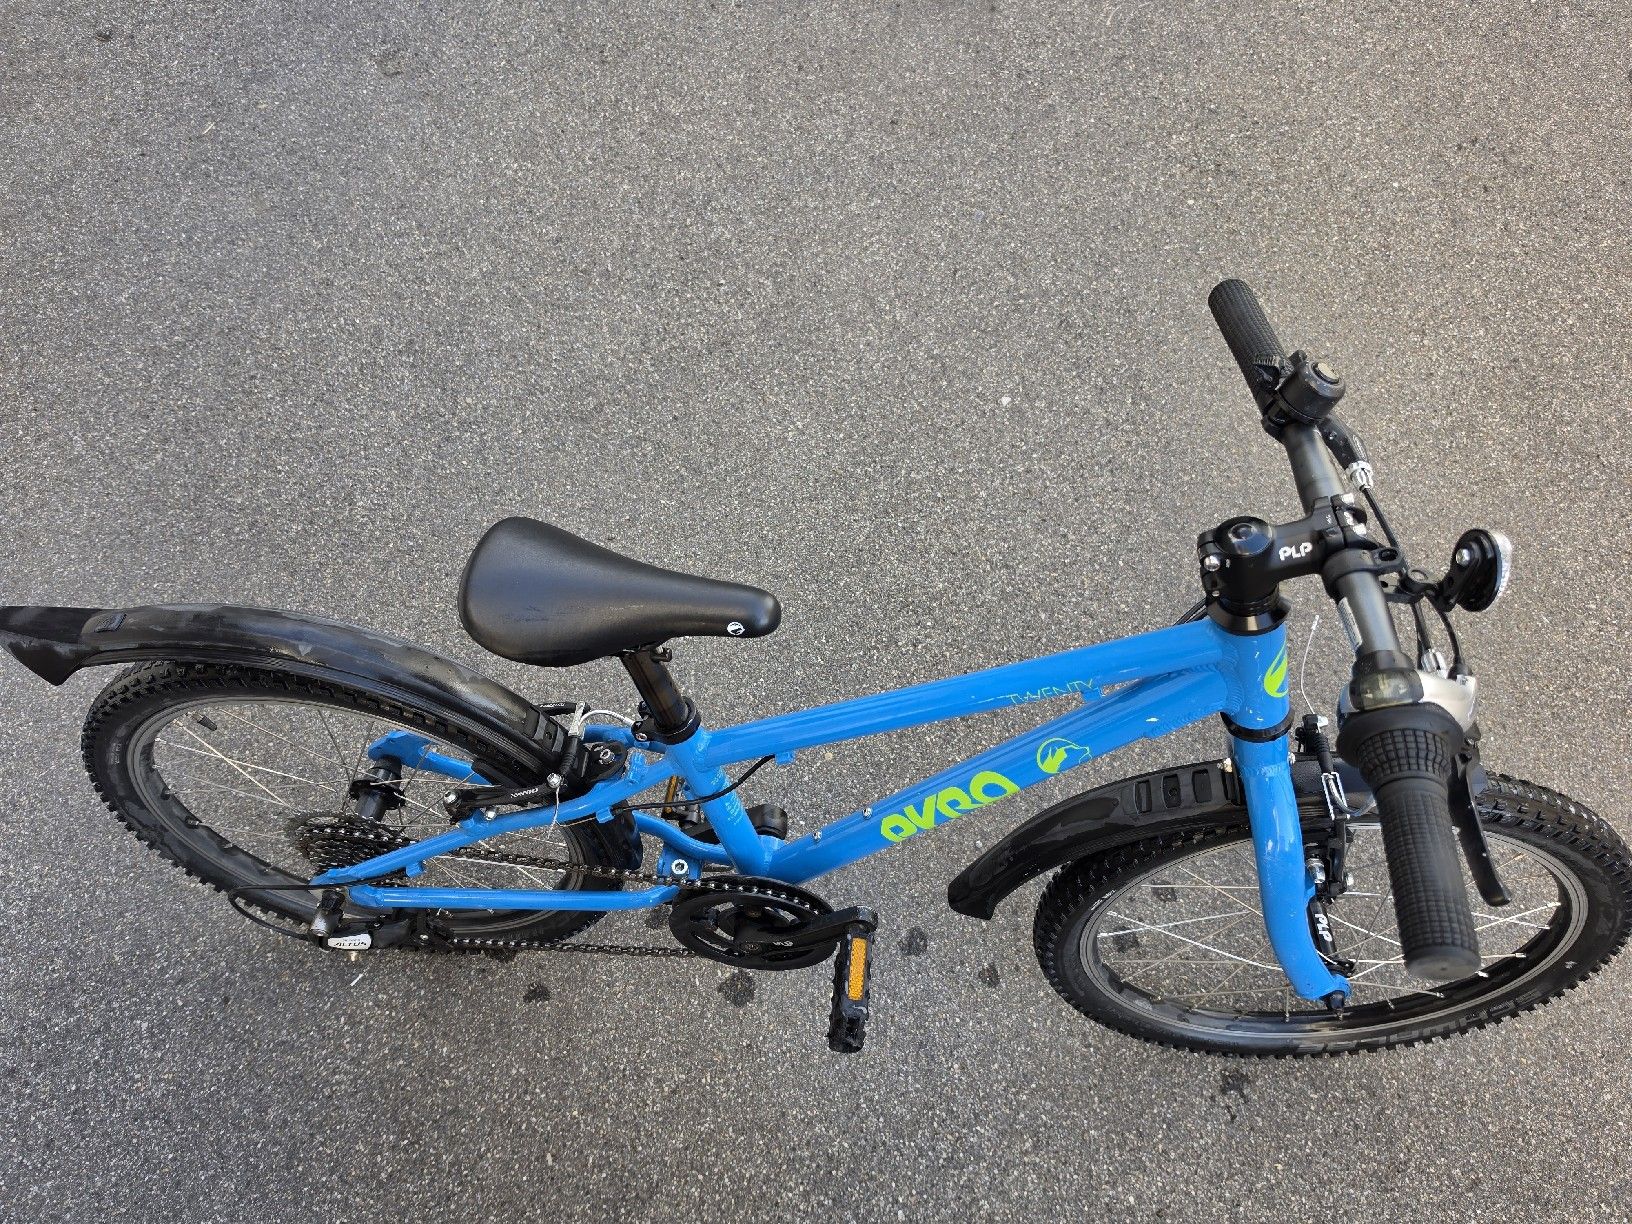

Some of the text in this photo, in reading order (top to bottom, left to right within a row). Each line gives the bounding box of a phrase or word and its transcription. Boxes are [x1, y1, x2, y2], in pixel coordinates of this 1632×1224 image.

[1278, 541, 1313, 561] PLP
[1006, 678, 1094, 704] TWENTY
[1314, 913, 1333, 942] PLP
